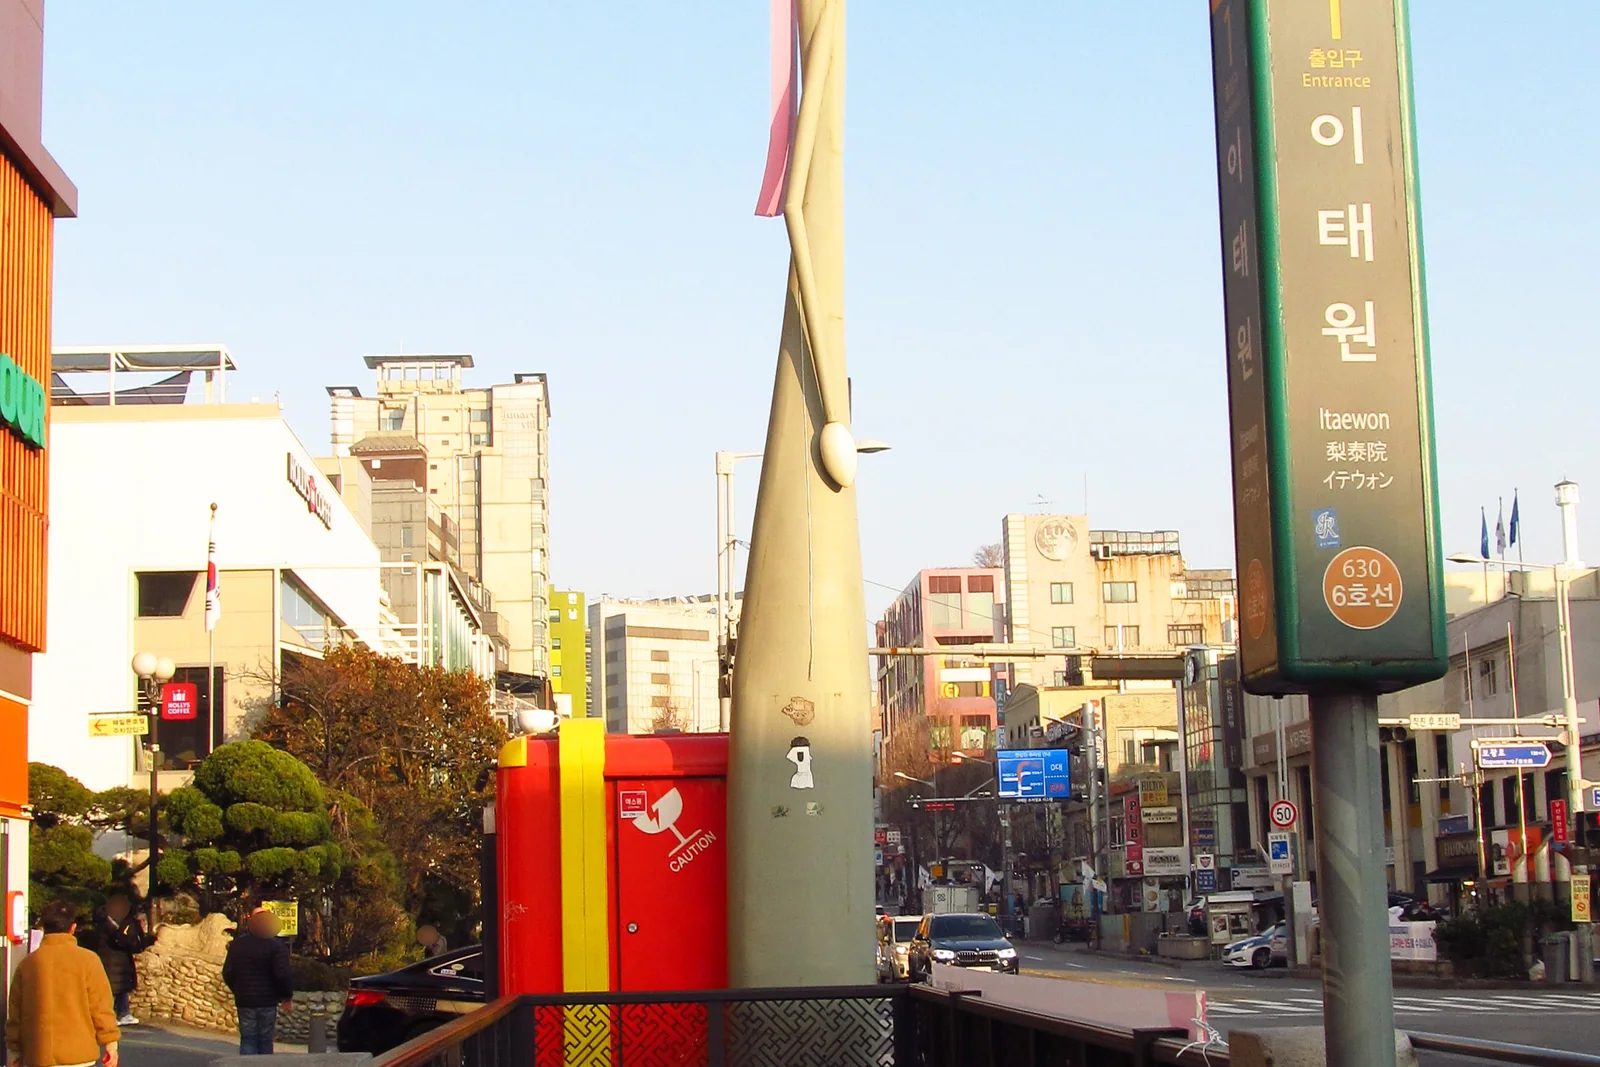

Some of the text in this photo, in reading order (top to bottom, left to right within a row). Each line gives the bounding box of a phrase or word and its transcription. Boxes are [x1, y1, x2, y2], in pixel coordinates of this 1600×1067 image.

[1308, 48, 1363, 69] 출입구
[1302, 72, 1371, 88] Entrance
[1310, 105, 1377, 362] 이태원
[1227, 126, 1253, 381] 이태원
[1319, 407, 1390, 430] Itaewon
[1326, 441, 1388, 463] 梨泰院
[1323, 469, 1394, 490] イテウォン
[1043, 527, 1071, 539] LUA
[1342, 559, 1381, 578] 630
[1332, 583, 1394, 608] 6호선
[1129, 800, 1139, 838] PUB
[1276, 807, 1292, 822] 50
[669, 830, 718, 873] CAUTION
